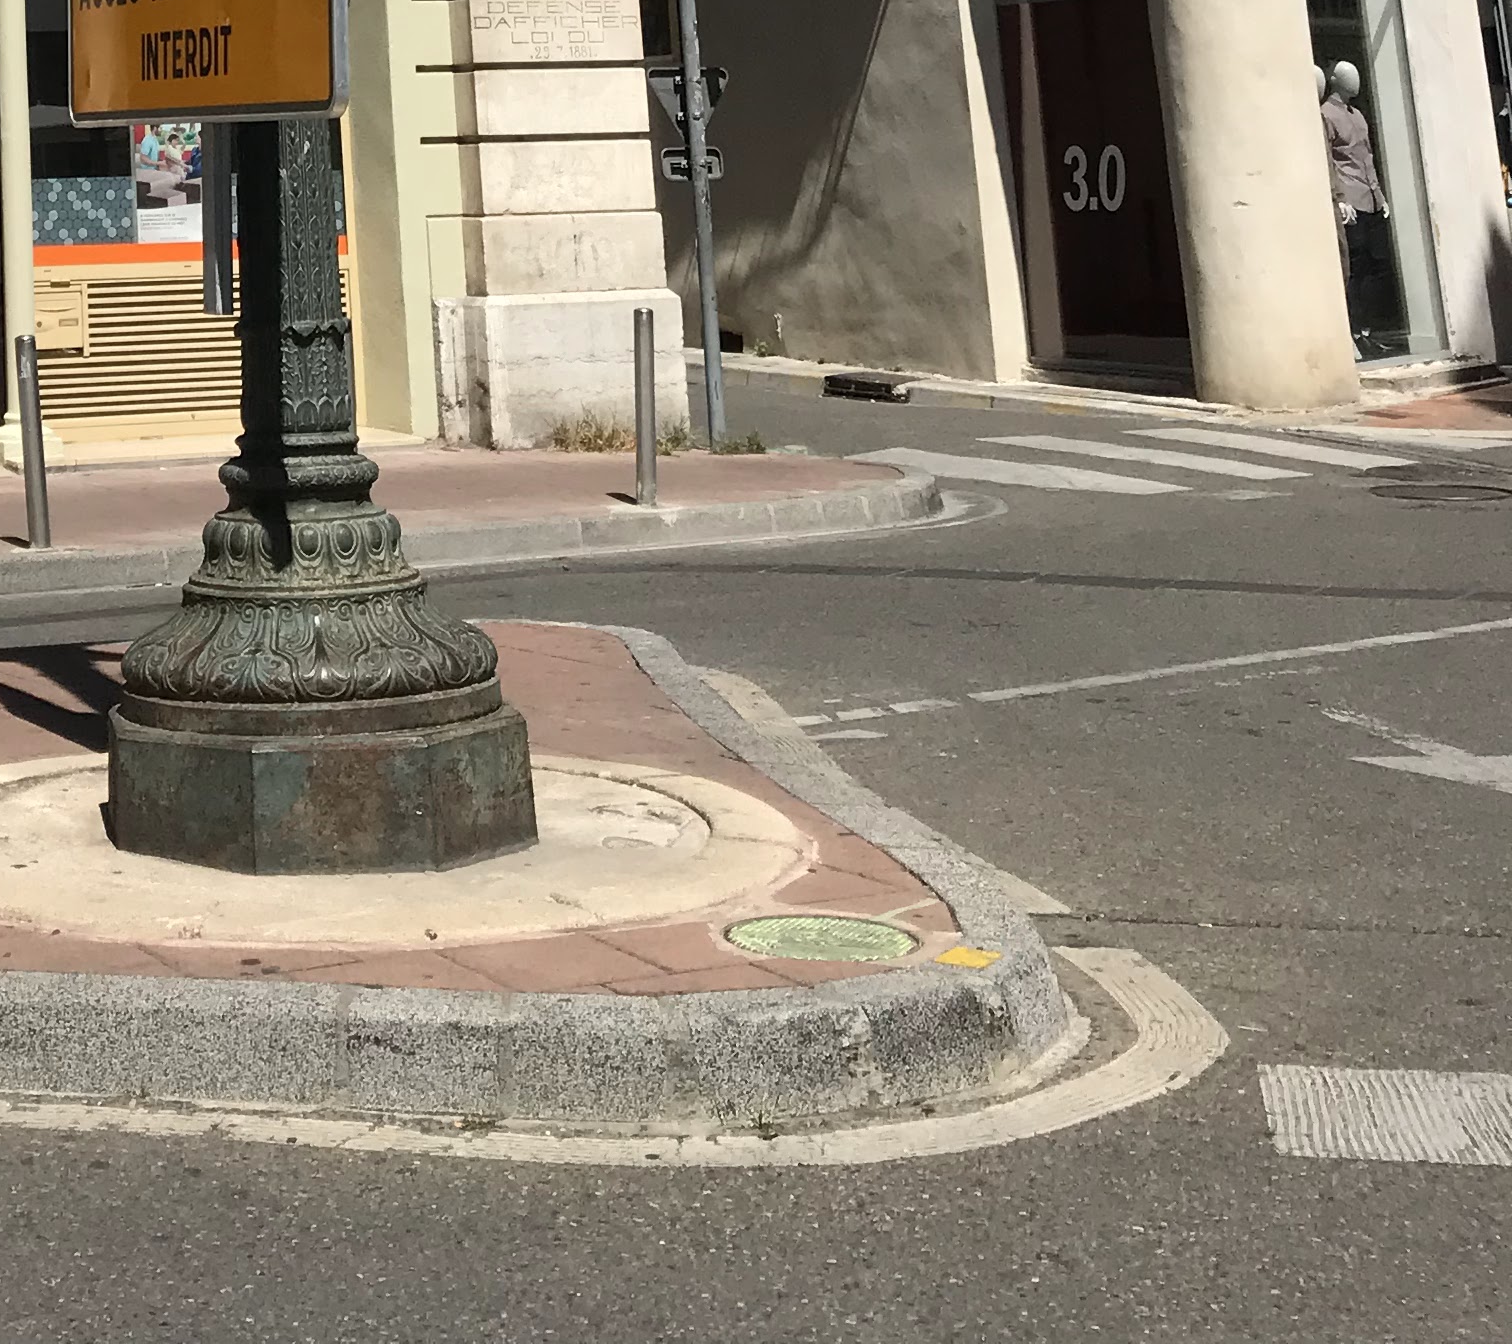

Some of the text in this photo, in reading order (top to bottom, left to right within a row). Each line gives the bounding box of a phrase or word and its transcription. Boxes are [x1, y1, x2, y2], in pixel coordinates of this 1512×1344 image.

[487, 0, 622, 14] DEFENSE
[474, 15, 640, 29] D'AFFICHER
[511, 30, 605, 44] LOI DU
[141, 24, 232, 82] INTERDIT
[1063, 144, 1126, 212] 3.0
